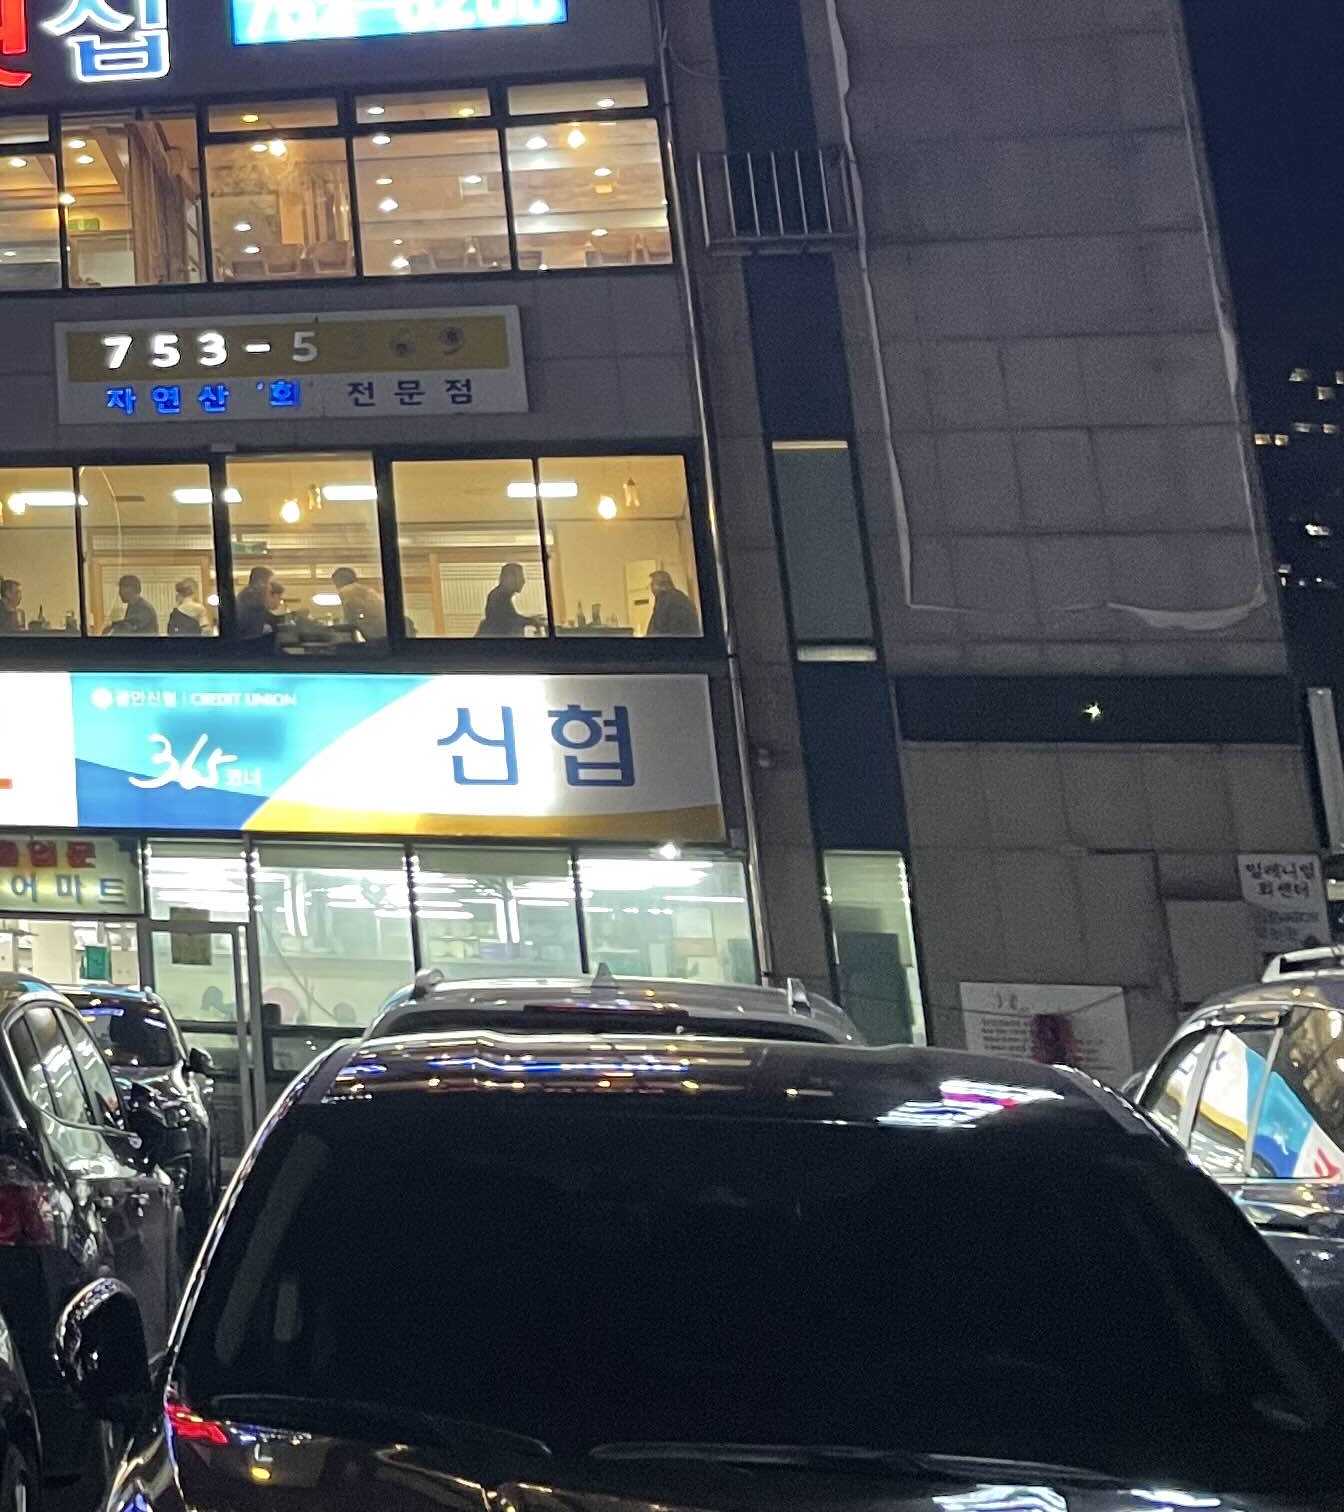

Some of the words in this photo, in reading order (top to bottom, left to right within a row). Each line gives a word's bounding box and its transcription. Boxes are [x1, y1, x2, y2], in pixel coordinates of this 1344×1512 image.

[106, 382, 229, 415] 자연산
[347, 377, 474, 408] 전문점
[437, 703, 635, 787] 신협
